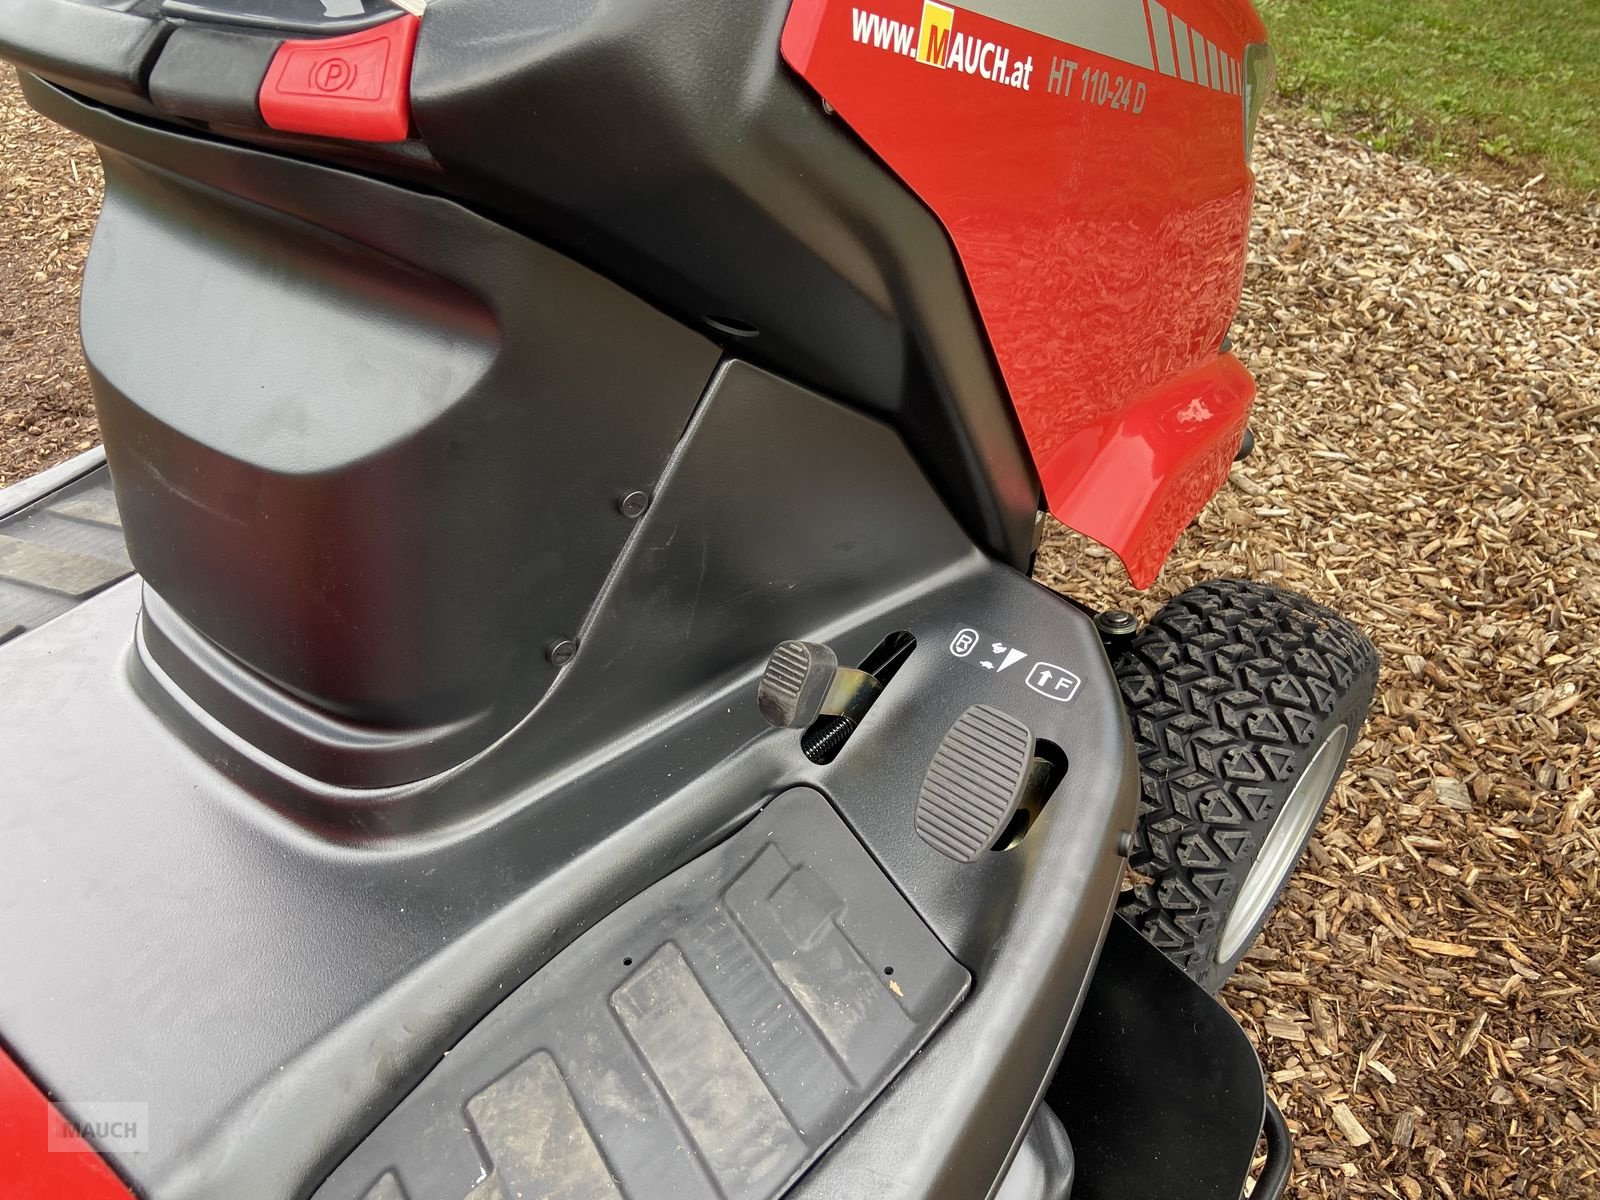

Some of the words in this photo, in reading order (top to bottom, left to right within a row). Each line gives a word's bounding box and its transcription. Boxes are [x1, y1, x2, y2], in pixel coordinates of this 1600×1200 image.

[852, 8, 1033, 90] www.MAUCH.at
[324, 64, 342, 87] P
[1047, 56, 1078, 96] HT
[1081, 67, 1132, 112] 110-24
[1133, 82, 1146, 114] D
[955, 634, 973, 652] R
[1054, 677, 1073, 690] F
